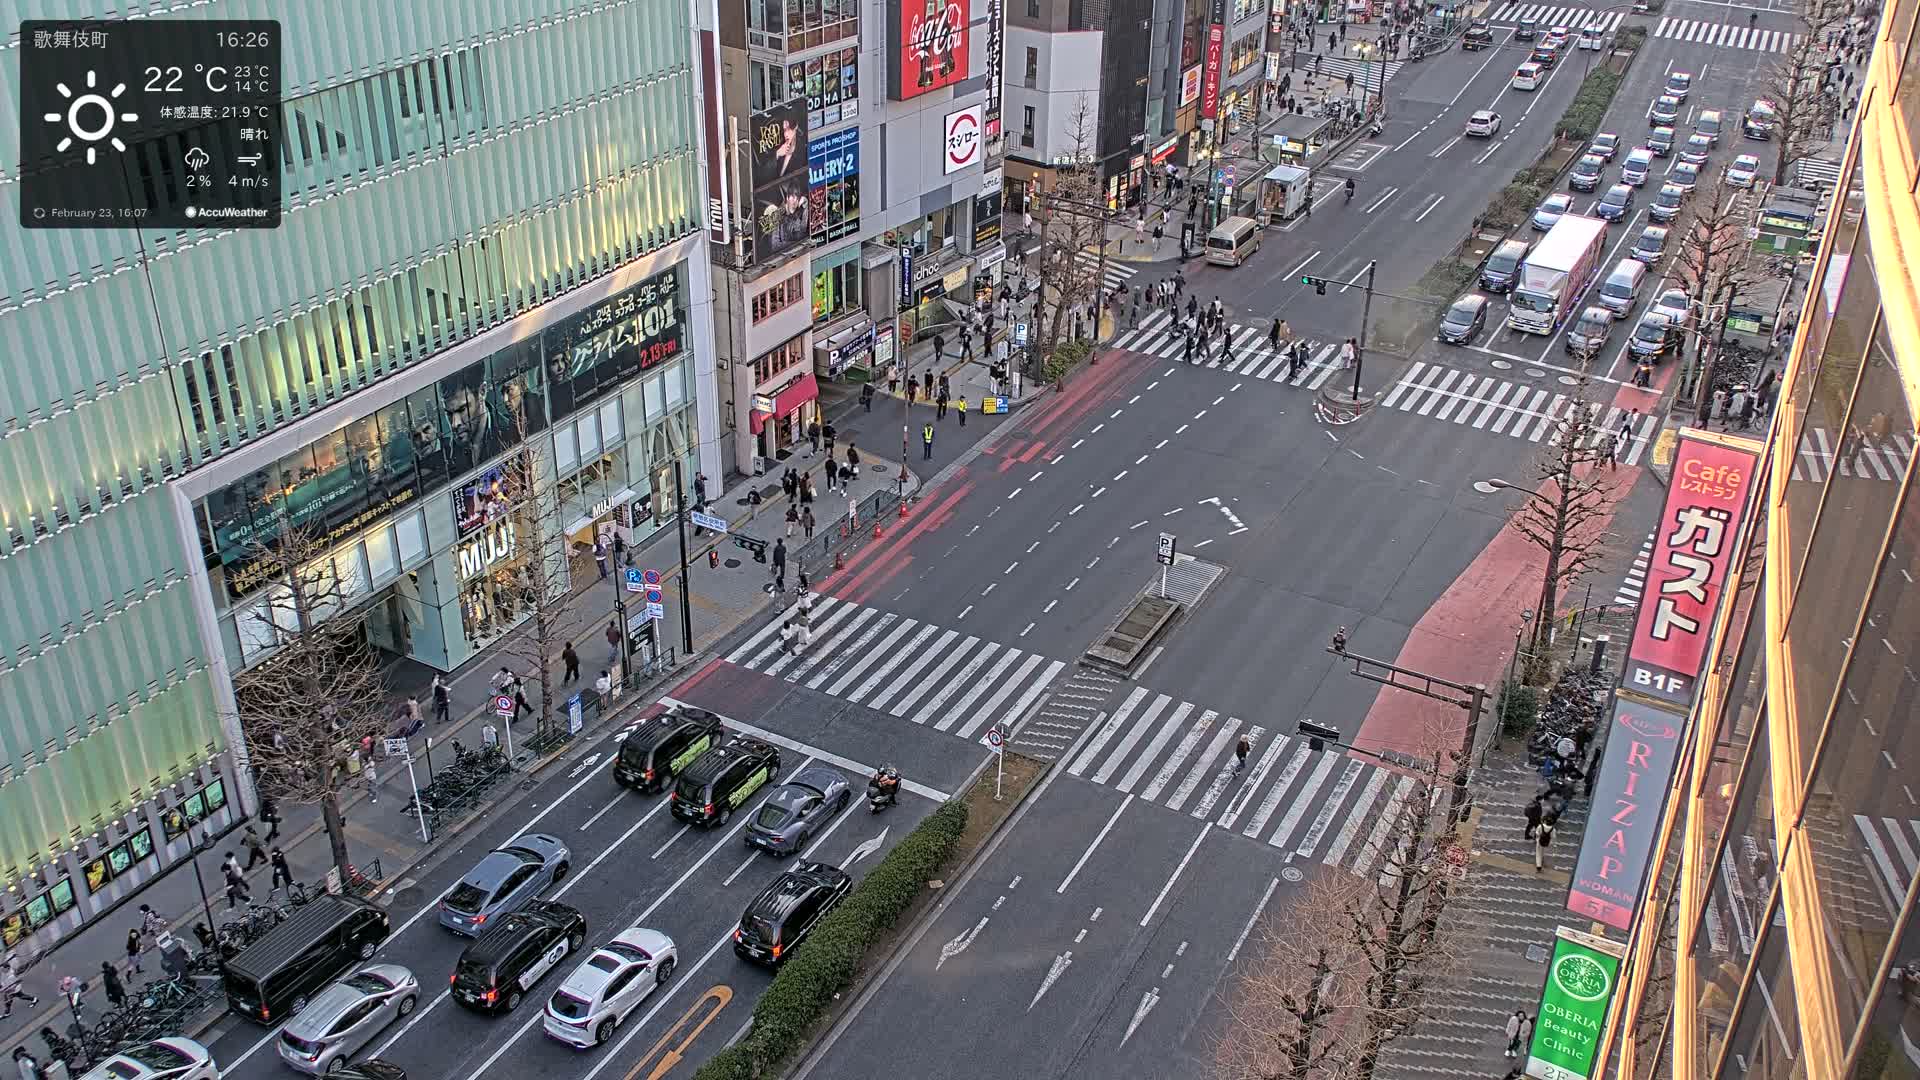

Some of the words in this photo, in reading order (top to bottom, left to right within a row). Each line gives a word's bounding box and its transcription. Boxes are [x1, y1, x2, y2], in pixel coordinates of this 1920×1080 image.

[1205, 43, 1220, 109] バーガーキング
[824, 86, 853, 105] HALL
[811, 139, 832, 153] SPORTS
[831, 135, 842, 145] PRO
[842, 131, 857, 141] SHOP
[948, 131, 979, 150] スシロー
[808, 153, 855, 185] ALLERY-2
[710, 198, 723, 232] MUJI
[829, 222, 858, 239] BASKETBALL
[913, 263, 939, 282] dhoc
[1018, 325, 1026, 334] P
[640, 342, 661, 369] 2.13
[829, 350, 839, 366] P
[997, 398, 1004, 408] P
[1683, 458, 1742, 488] Café
[1680, 477, 1737, 500] レストラン
[592, 496, 615, 518] MUJI
[458, 522, 517, 581] MUJI
[1651, 505, 1733, 641] ガスト
[1633, 667, 1685, 694] B1F
[1599, 741, 1653, 880] RIZAP
[1579, 879, 1634, 904] WOMAN
[1585, 901, 1616, 919] 5F
[549, 946, 563, 964] GO
[1559, 968, 1601, 990] OBERIA
[1544, 1002, 1599, 1031] OBERIA
[1543, 1018, 1592, 1045] Beauty
[1543, 1037, 1585, 1060] Clinic
